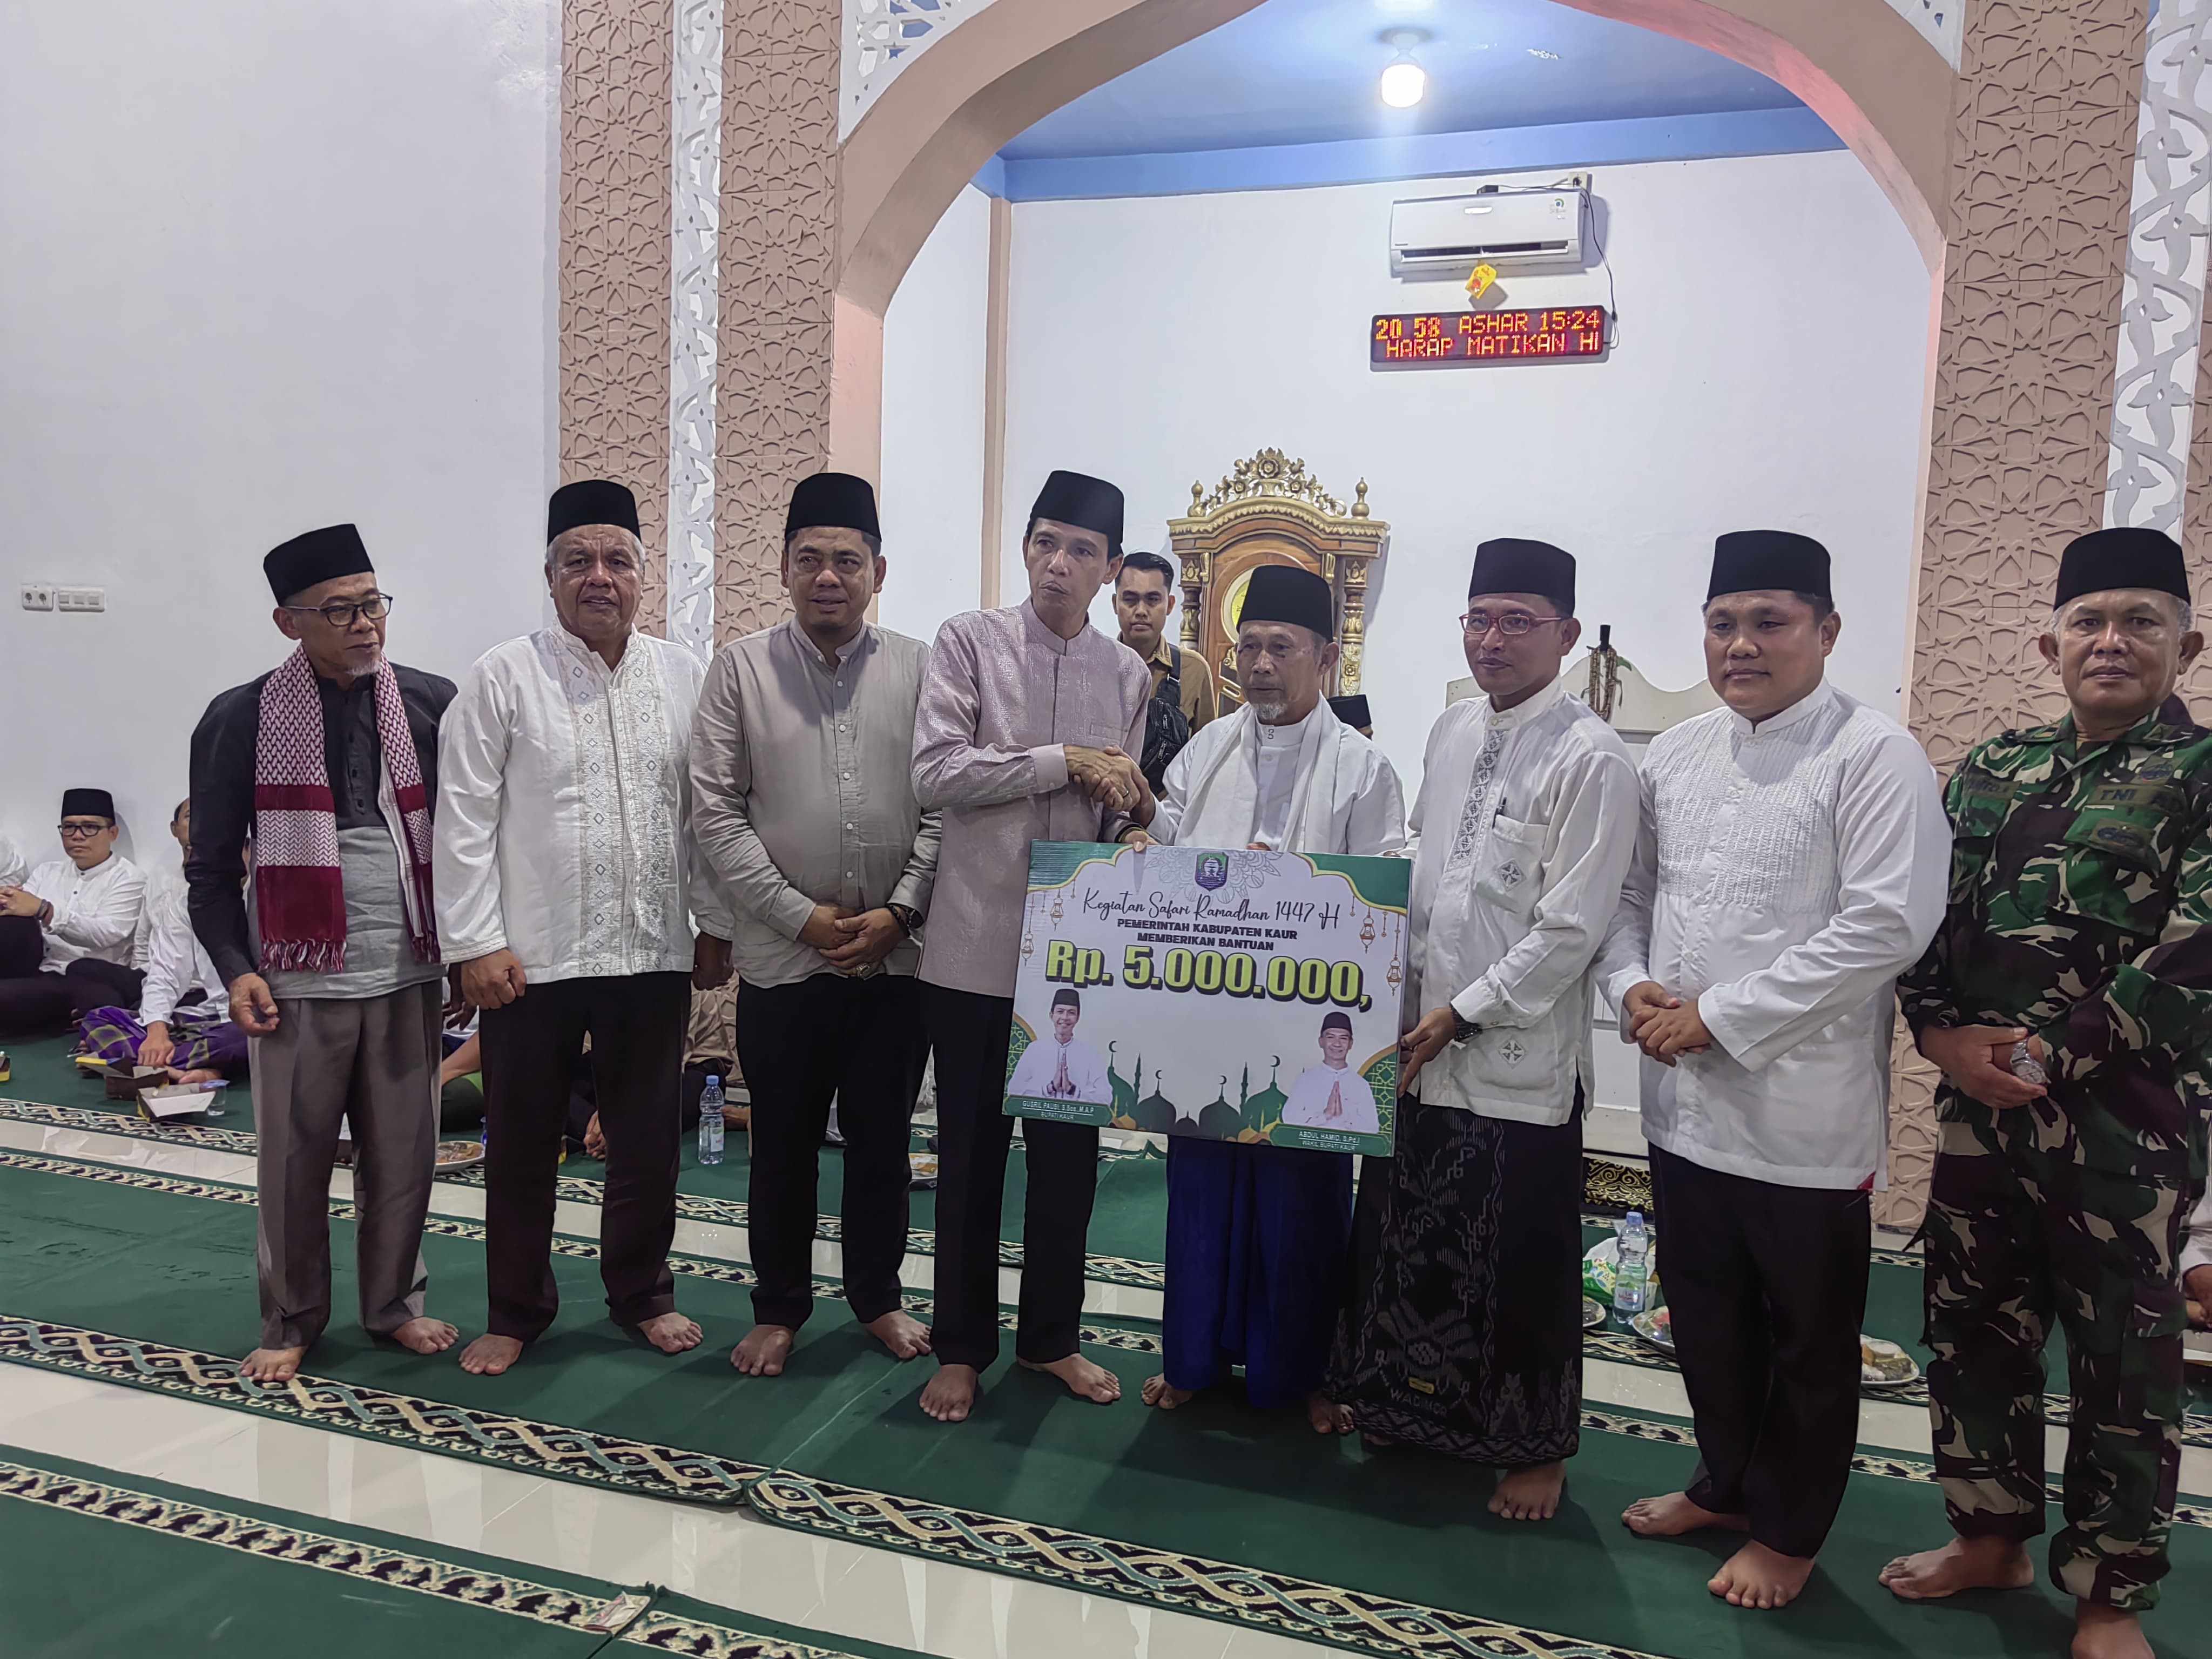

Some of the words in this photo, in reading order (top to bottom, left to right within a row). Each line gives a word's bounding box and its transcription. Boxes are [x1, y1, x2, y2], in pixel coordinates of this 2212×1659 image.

[1459, 314, 1528, 334] ASHAR
[1540, 309, 1600, 331] 15:24
[1386, 338, 1453, 358] HARAP
[1467, 332, 1565, 355] MATIKAN
[2100, 790, 2137, 800] TNI
[1083, 887, 1145, 920] Kegiatan
[1149, 892, 1190, 919] Safari
[1193, 894, 1270, 921] Ramadhan
[1276, 901, 1314, 922] 1447
[1318, 902, 1340, 929] H
[1117, 919, 1190, 932] PEMERINTAH
[1192, 923, 1262, 937] KABUPATEN
[1265, 929, 1298, 940] KAUR
[1137, 933, 1216, 946] MEMBERIKAN
[1218, 938, 1274, 950] BANTUAN
[1046, 939, 1114, 989] Rp.
[1123, 945, 1372, 1013] 5.000.000,
[1298, 1131, 1318, 1139] ABDUL
